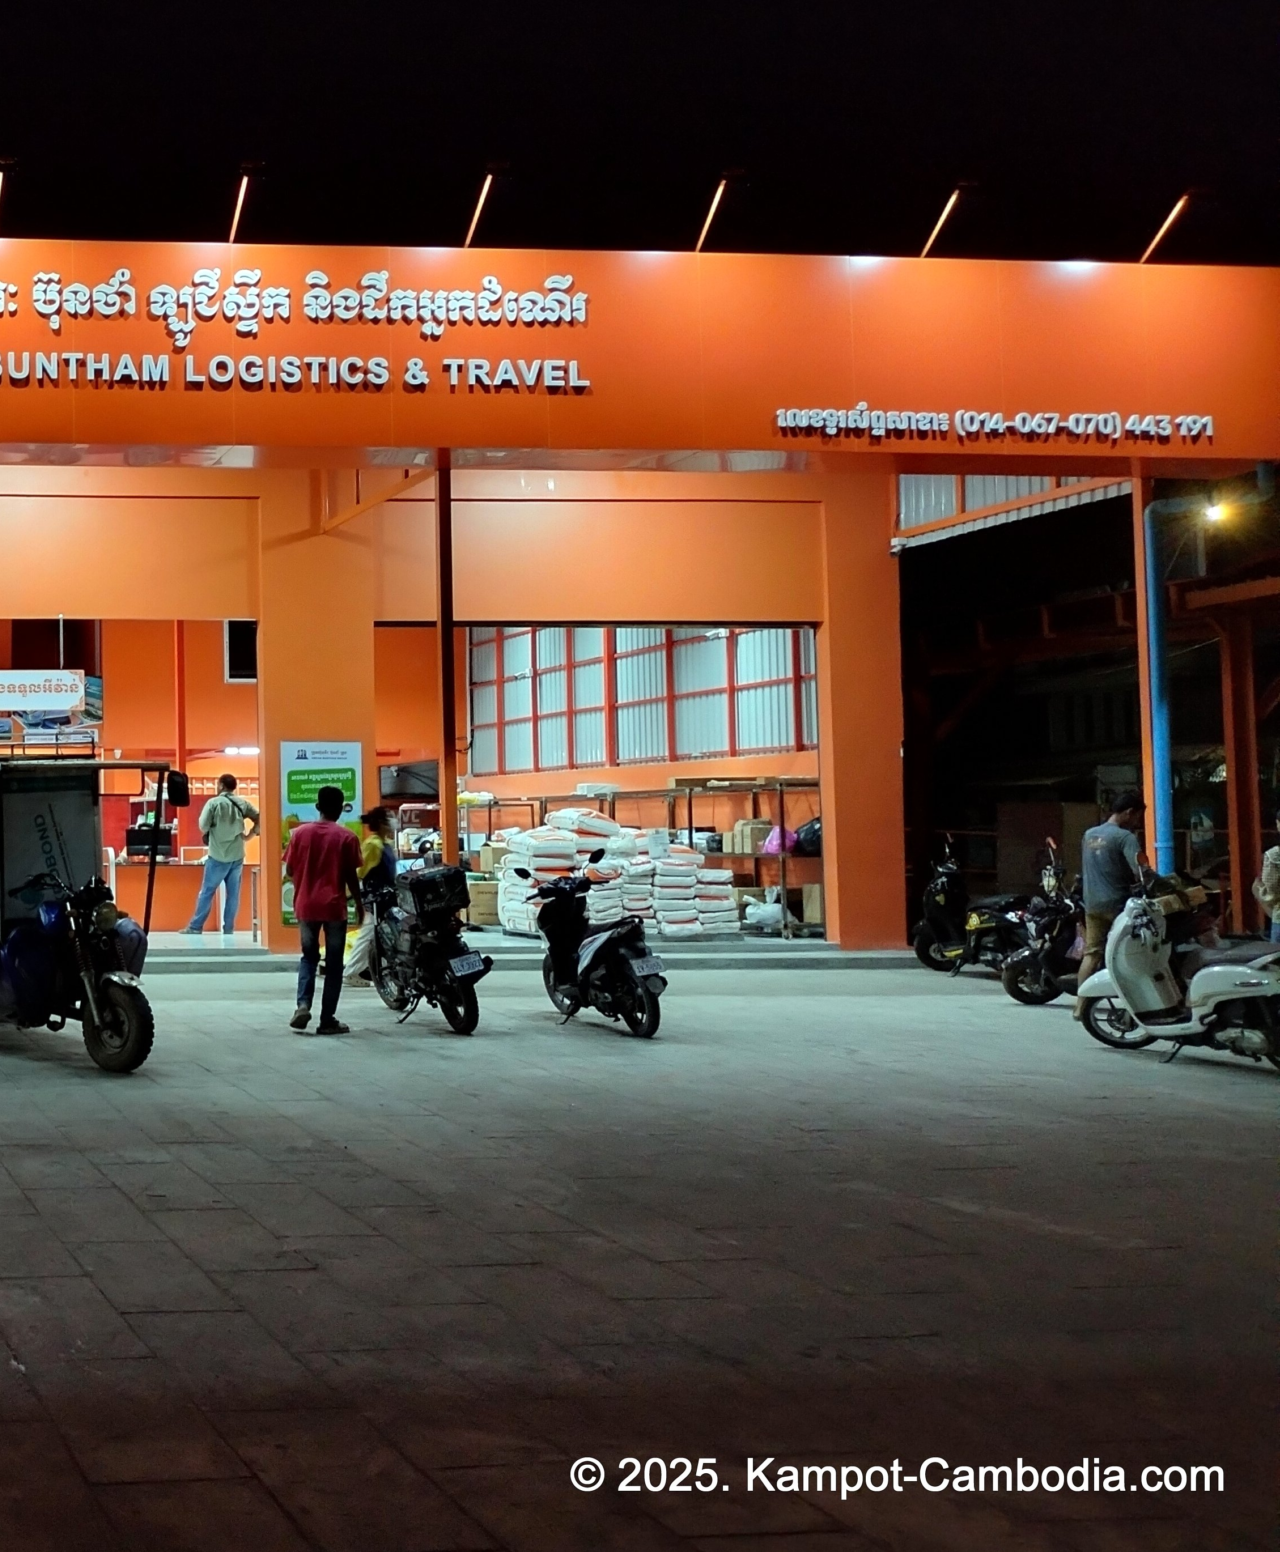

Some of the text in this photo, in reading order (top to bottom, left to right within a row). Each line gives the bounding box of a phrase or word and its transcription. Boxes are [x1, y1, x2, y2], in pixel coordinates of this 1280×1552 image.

[32, 268, 136, 330] ប៊ុនថាំ
[185, 354, 390, 385] LOGISTICS
[403, 358, 430, 386] &
[442, 358, 591, 388] TRAVEL
[954, 409, 1122, 439] (014-067-070)
[1125, 413, 1172, 437] 443
[1174, 415, 1214, 438] 191
